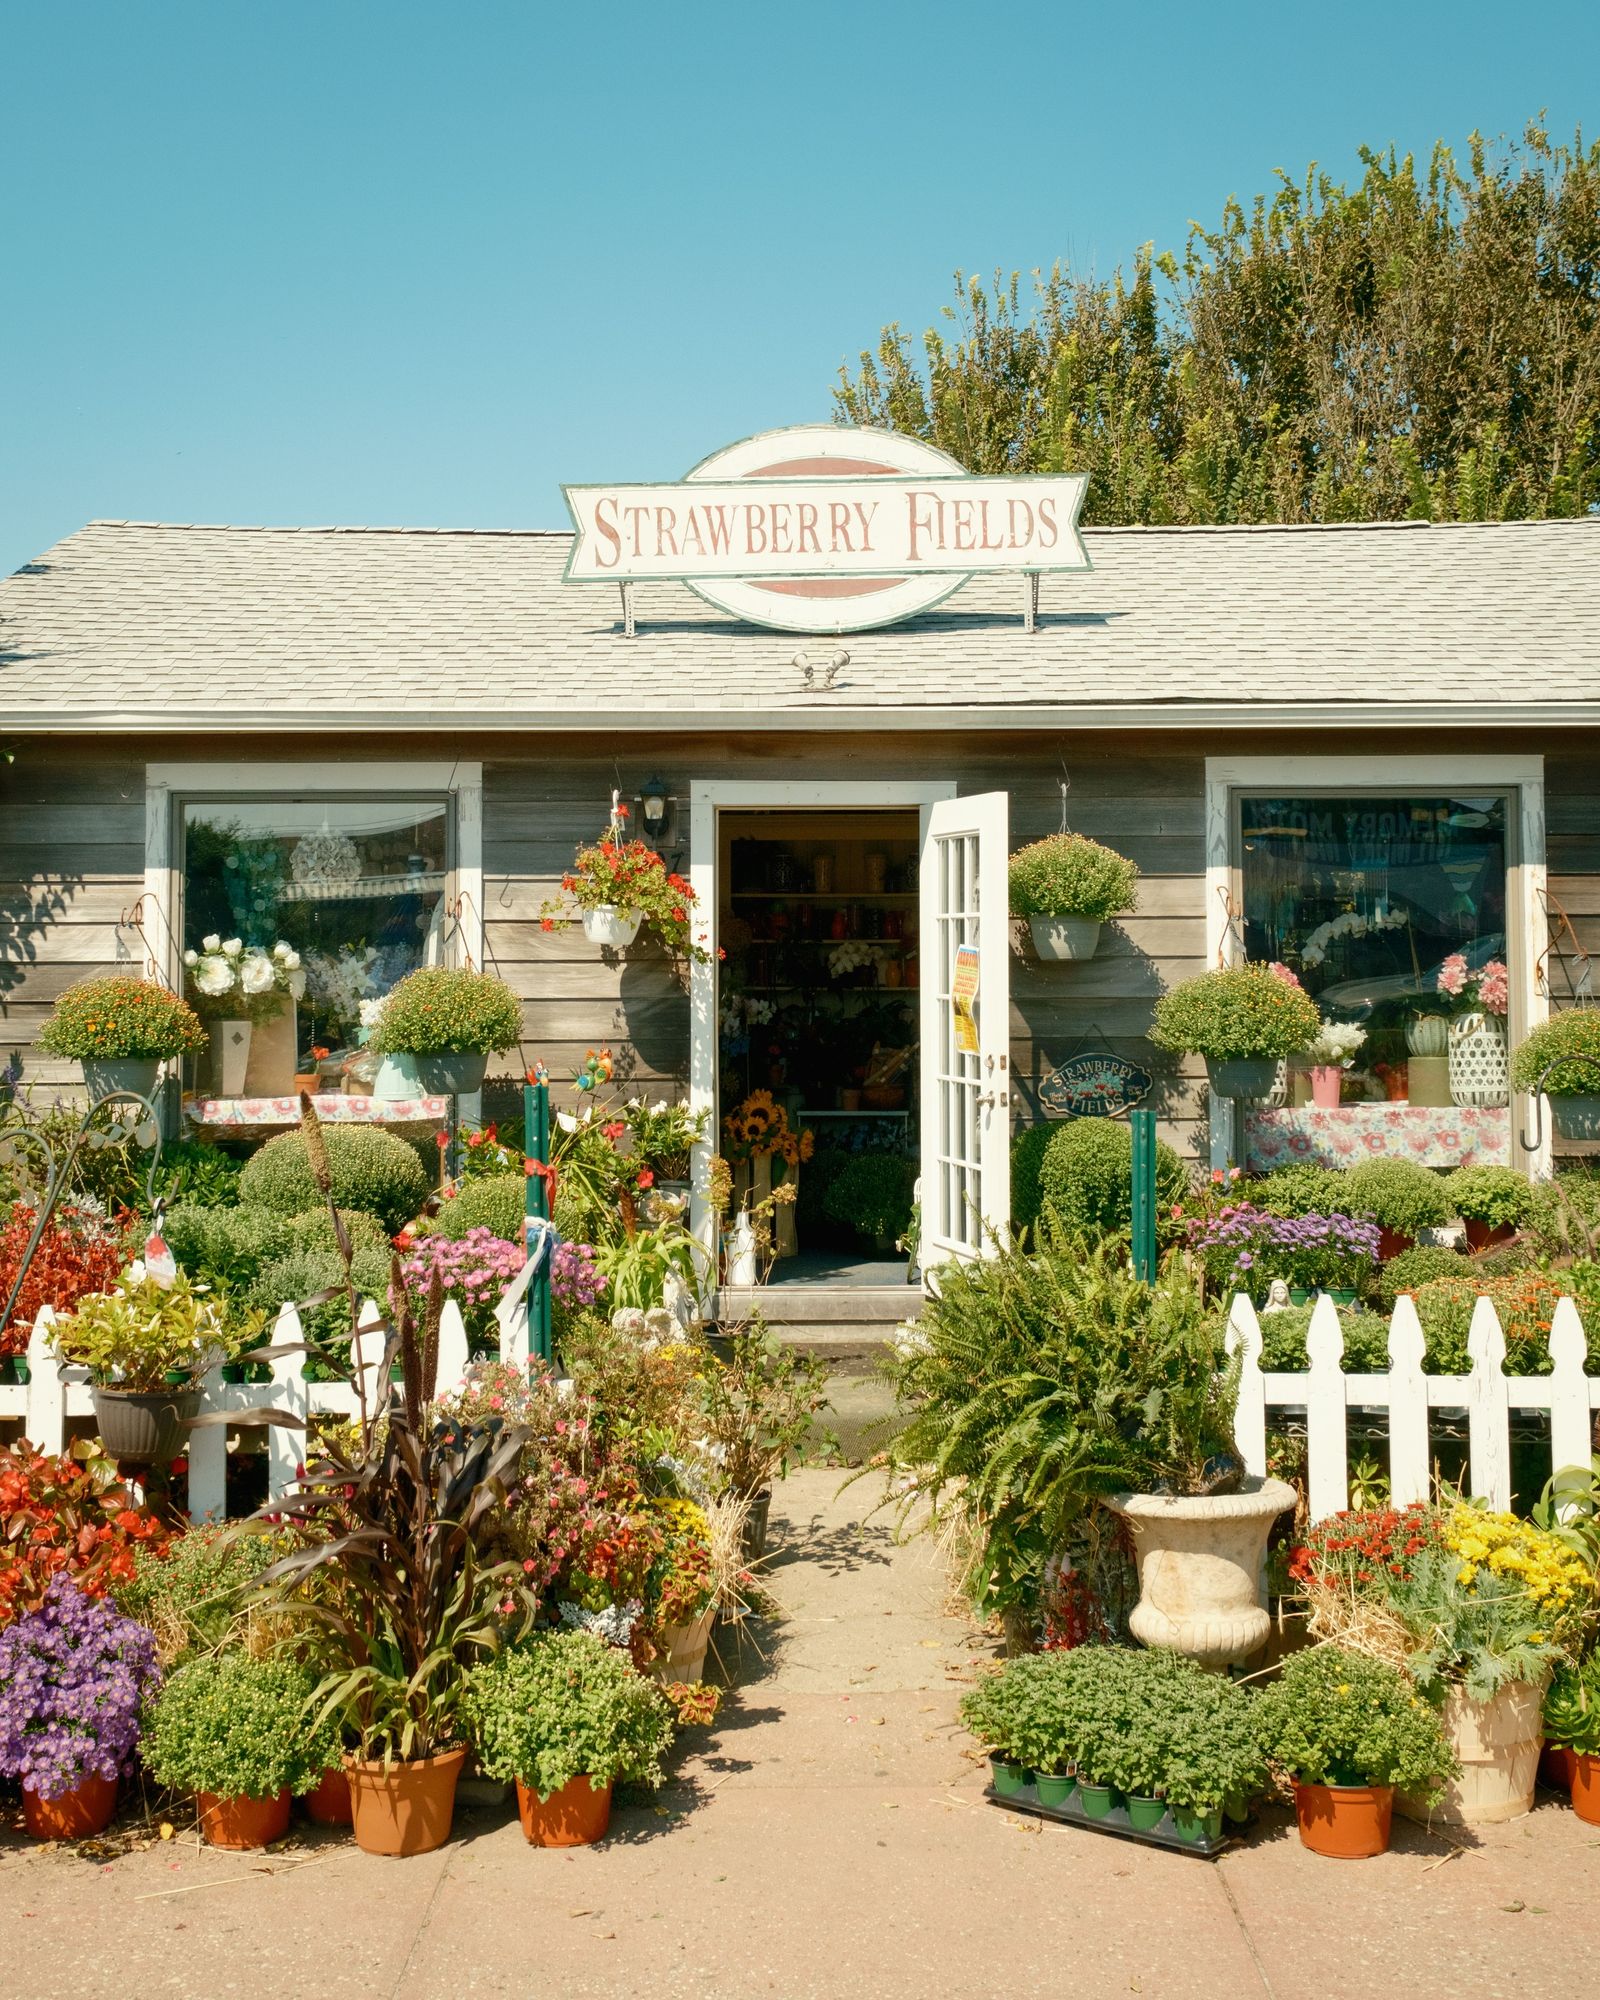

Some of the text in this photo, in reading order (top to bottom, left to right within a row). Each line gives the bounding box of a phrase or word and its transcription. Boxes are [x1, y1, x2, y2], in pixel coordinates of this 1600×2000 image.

[594, 491, 1059, 569] STRAWBERRY FIELDS
[1051, 1060, 1137, 1088] STRAWBERRY
[1070, 1093, 1125, 1114] FIELDS
